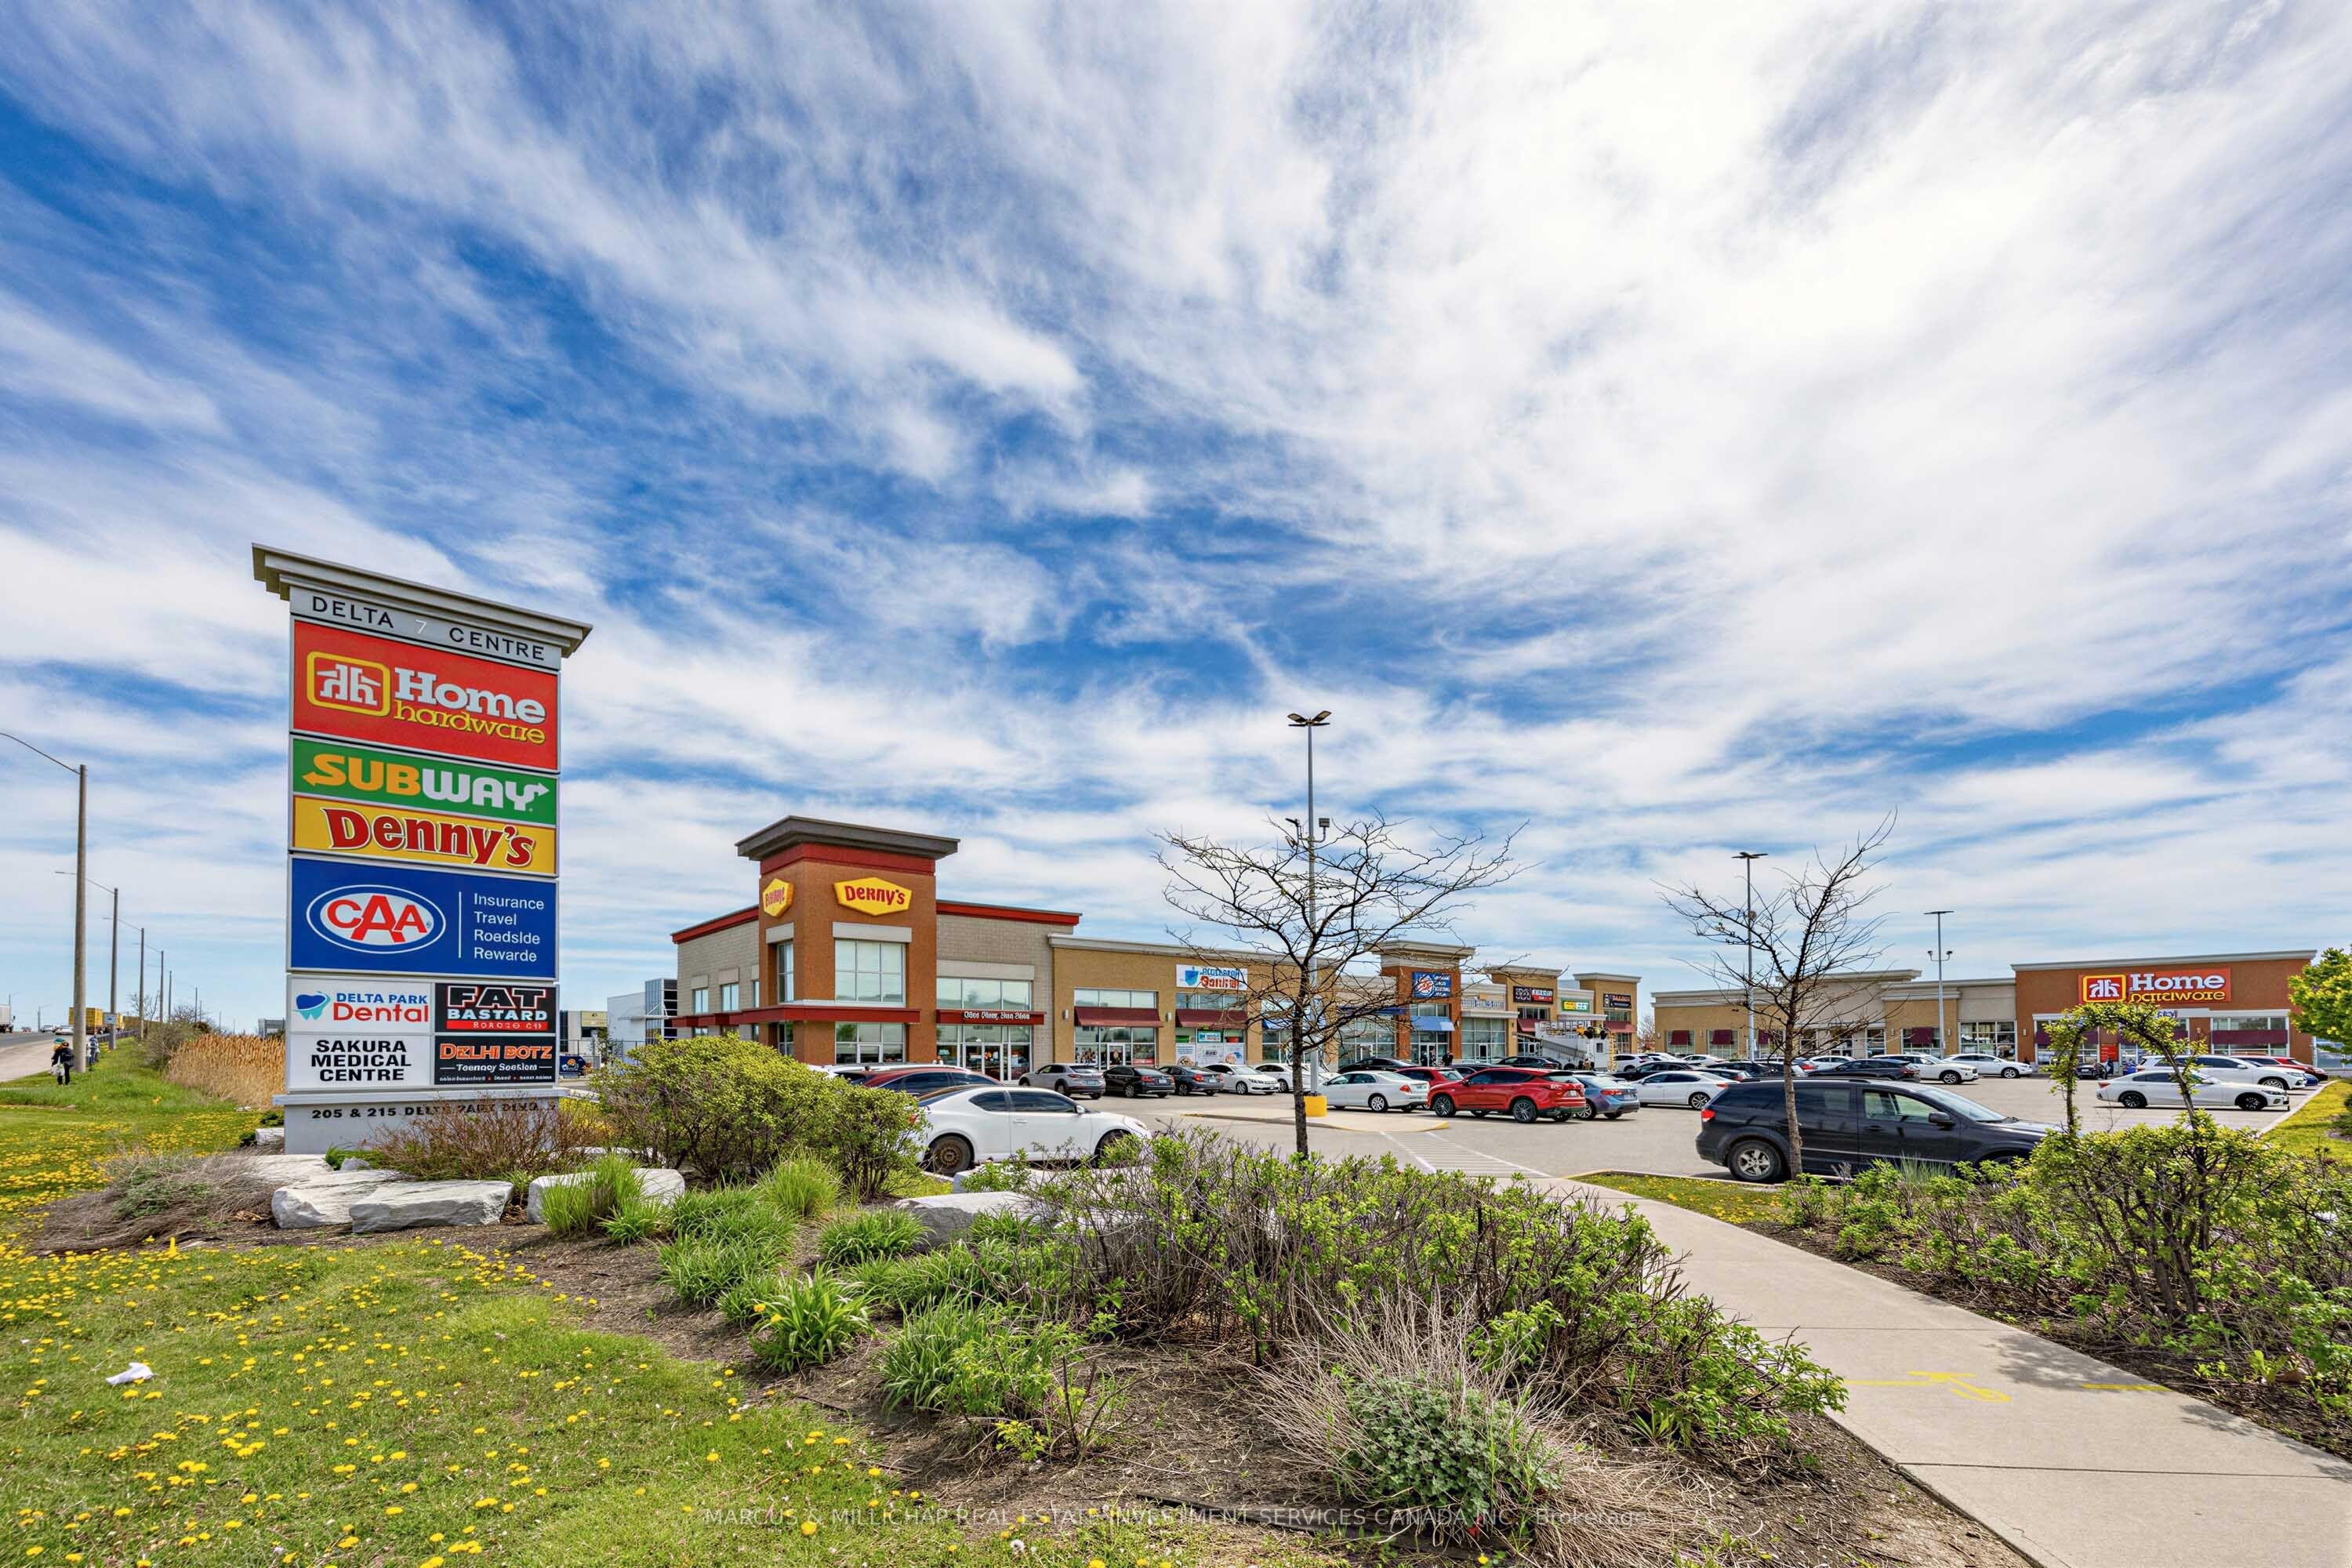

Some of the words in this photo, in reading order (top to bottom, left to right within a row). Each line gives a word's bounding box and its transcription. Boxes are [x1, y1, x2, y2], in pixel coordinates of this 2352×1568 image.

[312, 595, 394, 629] DELTA
[415, 619, 428, 634] 7
[448, 627, 545, 660] CENTRE
[394, 667, 546, 724] Home
[394, 699, 546, 744] hardware
[302, 753, 550, 812] SUBWAY
[321, 808, 535, 866] Denny's
[474, 892, 545, 910] Insurance
[326, 895, 428, 944] CAA
[474, 911, 517, 926] Travel
[2129, 973, 2226, 992] Home
[336, 993, 384, 1004] DELTA
[388, 994, 428, 1004] PARK
[447, 985, 547, 1010] FAT
[332, 1002, 430, 1023] Dental
[447, 1008, 548, 1021] BASTARD
[315, 1039, 408, 1053] SAKURA
[311, 1054, 412, 1068] MEDICAL
[319, 1068, 405, 1083] CENTRE
[312, 1109, 343, 1119] 205
[350, 1109, 361, 1118] &
[367, 1107, 397, 1118] 215
